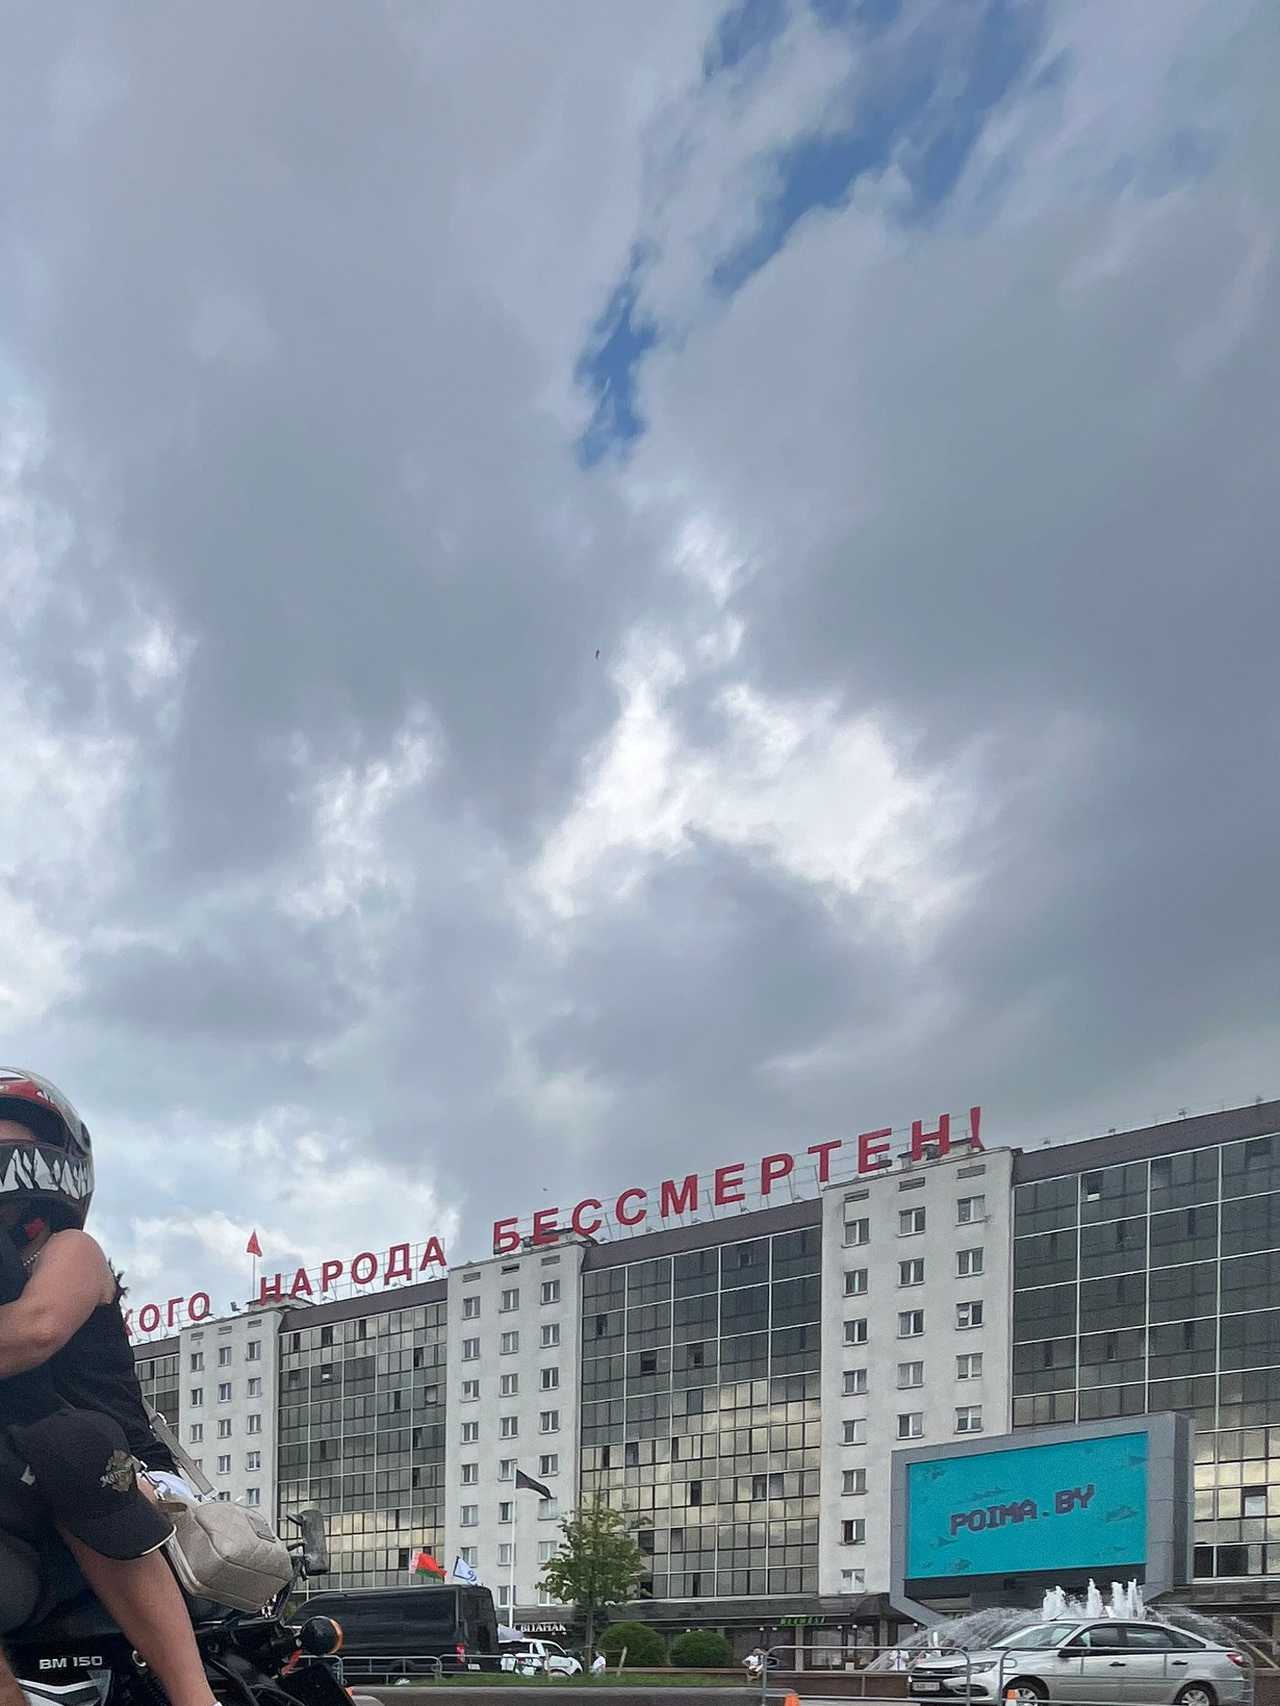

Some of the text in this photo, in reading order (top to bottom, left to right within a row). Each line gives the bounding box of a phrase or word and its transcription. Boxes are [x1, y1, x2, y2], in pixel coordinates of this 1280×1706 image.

[260, 1236, 447, 1307] НАРОДА
[493, 1106, 981, 1255] БЕССМЕРТЕН!
[39, 1656, 103, 1670] BM 150
